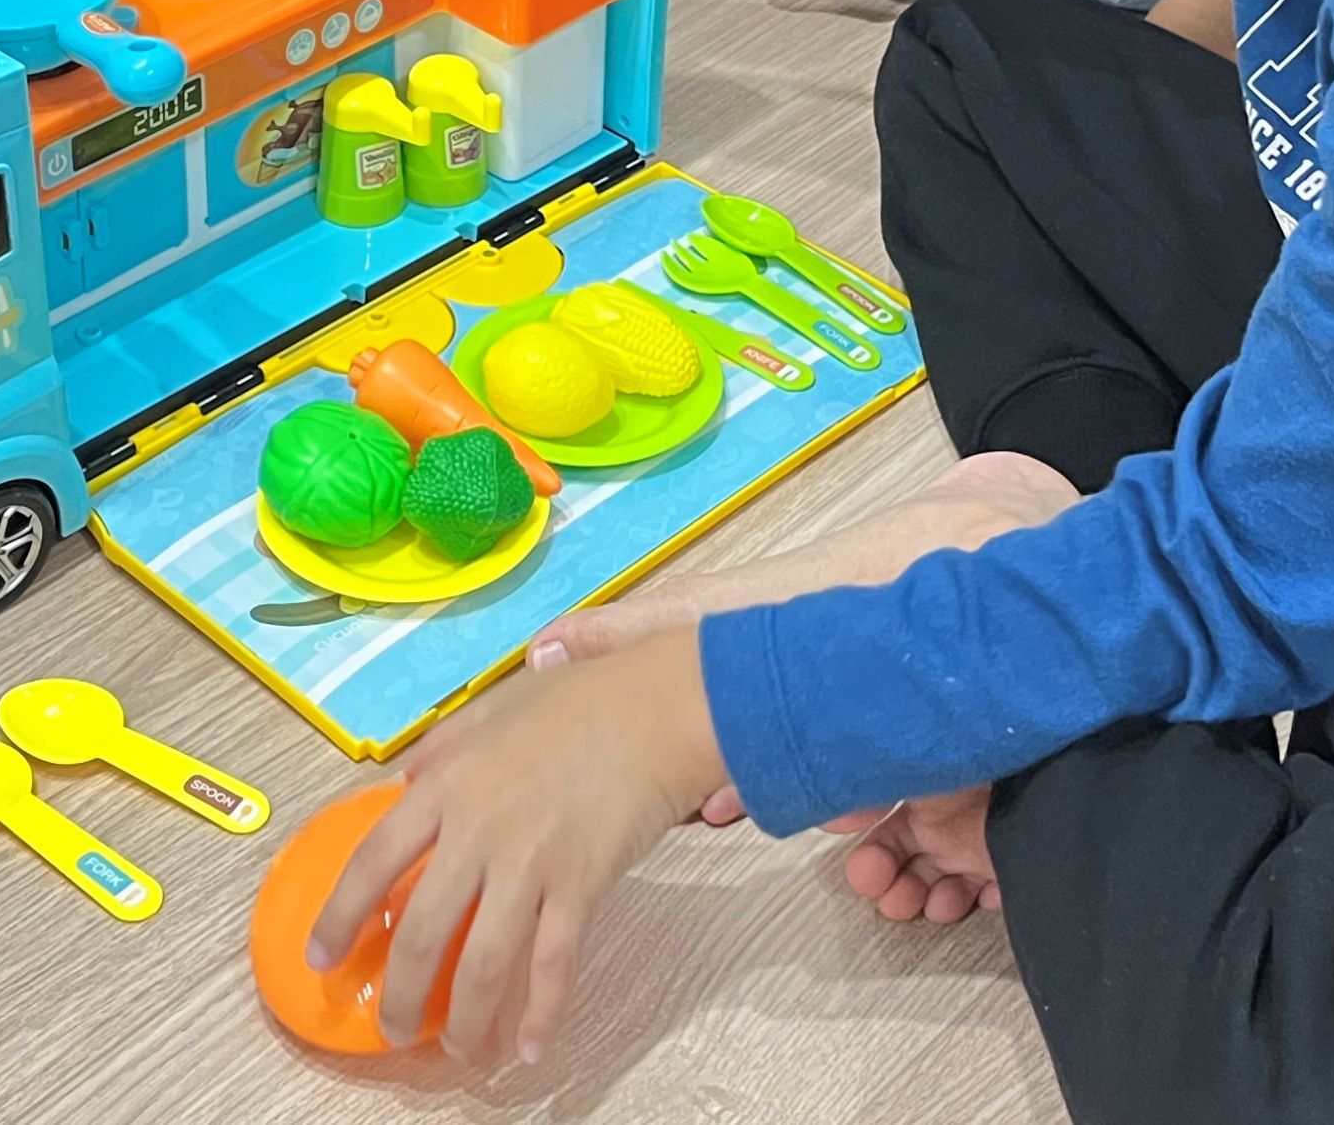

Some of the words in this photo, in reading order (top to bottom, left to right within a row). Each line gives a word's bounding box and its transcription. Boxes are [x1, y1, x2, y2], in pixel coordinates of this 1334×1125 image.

[1284, 159, 1327, 210] 18
[840, 285, 876, 311] SPOON
[819, 324, 850, 347] FORK
[743, 347, 781, 371] KNIFE
[190, 779, 235, 808] SPOON
[84, 856, 124, 887] FORK
